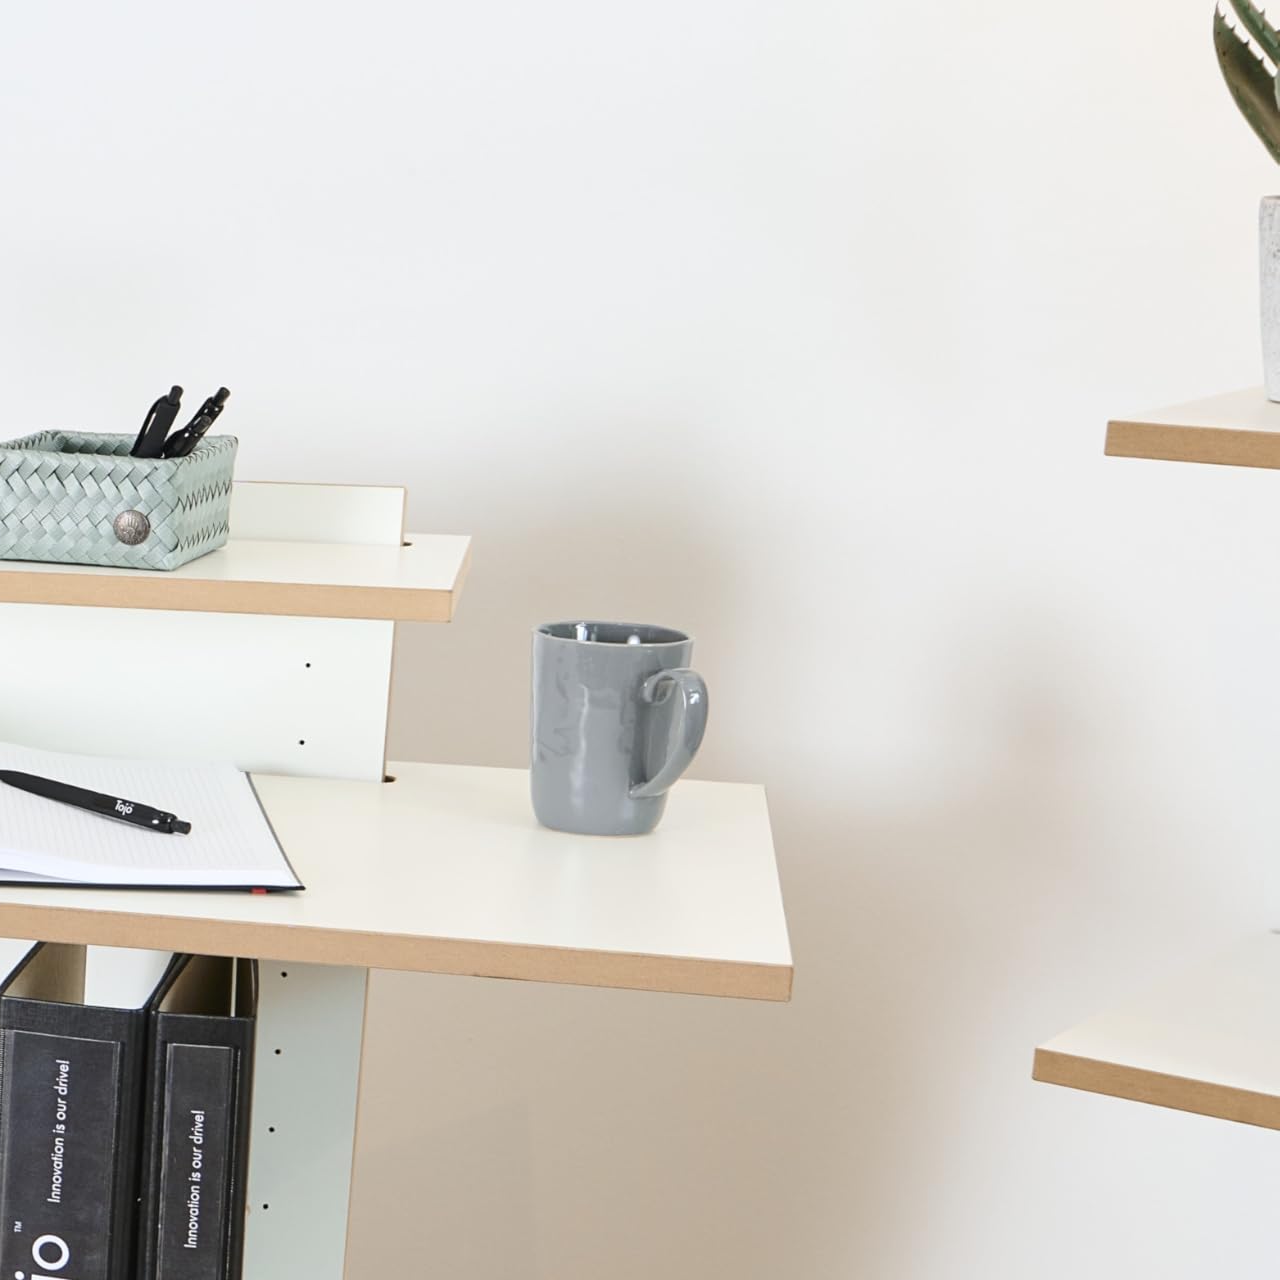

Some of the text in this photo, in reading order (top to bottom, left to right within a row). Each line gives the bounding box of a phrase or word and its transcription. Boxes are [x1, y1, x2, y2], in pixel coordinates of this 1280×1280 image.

[115, 799, 134, 816] Tojo
[46, 1059, 70, 1203] Innovation is our drive!
[183, 1109, 205, 1249] Innovation is our drive!
